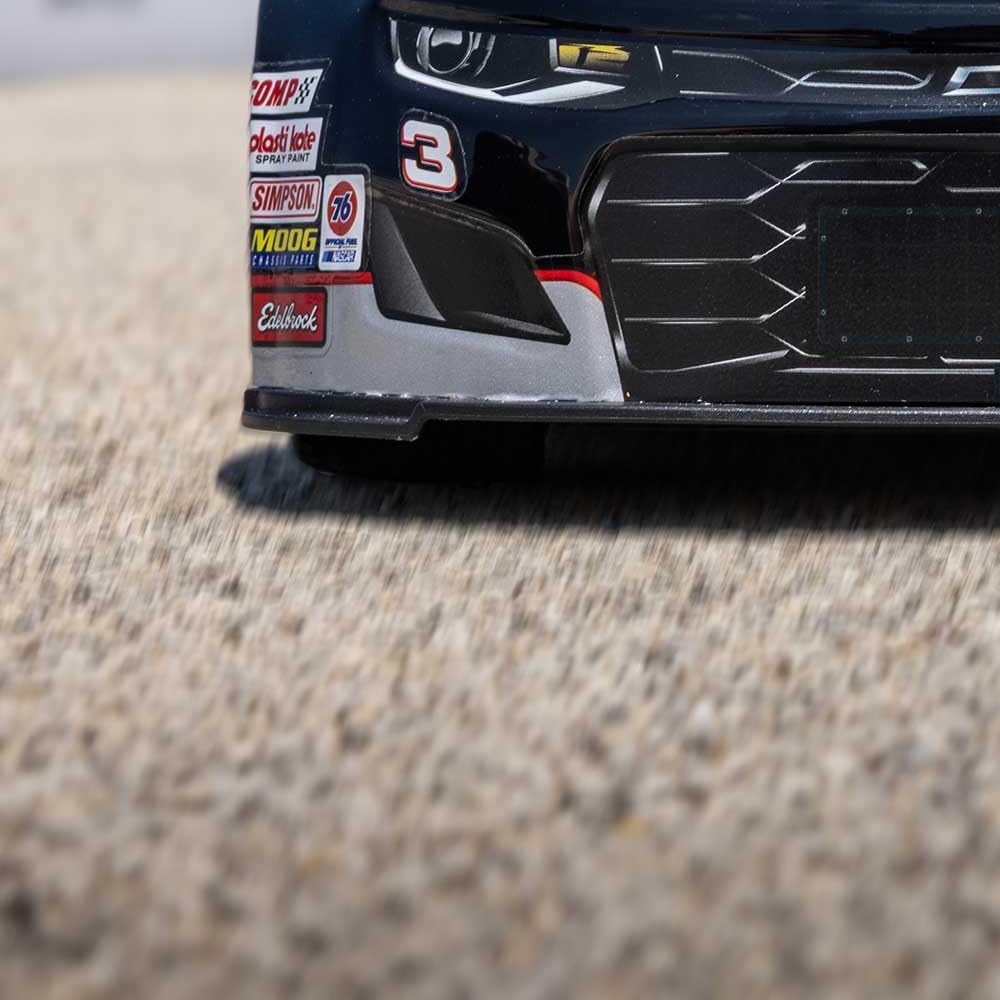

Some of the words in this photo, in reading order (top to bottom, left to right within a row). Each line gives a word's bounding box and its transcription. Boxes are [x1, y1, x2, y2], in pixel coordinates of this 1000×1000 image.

[290, 124, 316, 152] kote
[255, 154, 287, 165] SPRAY
[288, 152, 310, 163] PAINT
[401, 119, 458, 193] 3
[330, 190, 353, 223] 76
[251, 228, 319, 253] MOOG
[252, 255, 287, 267] CHASSIS
[289, 254, 315, 266] PARTS
[257, 302, 318, 332] Edelbrock
